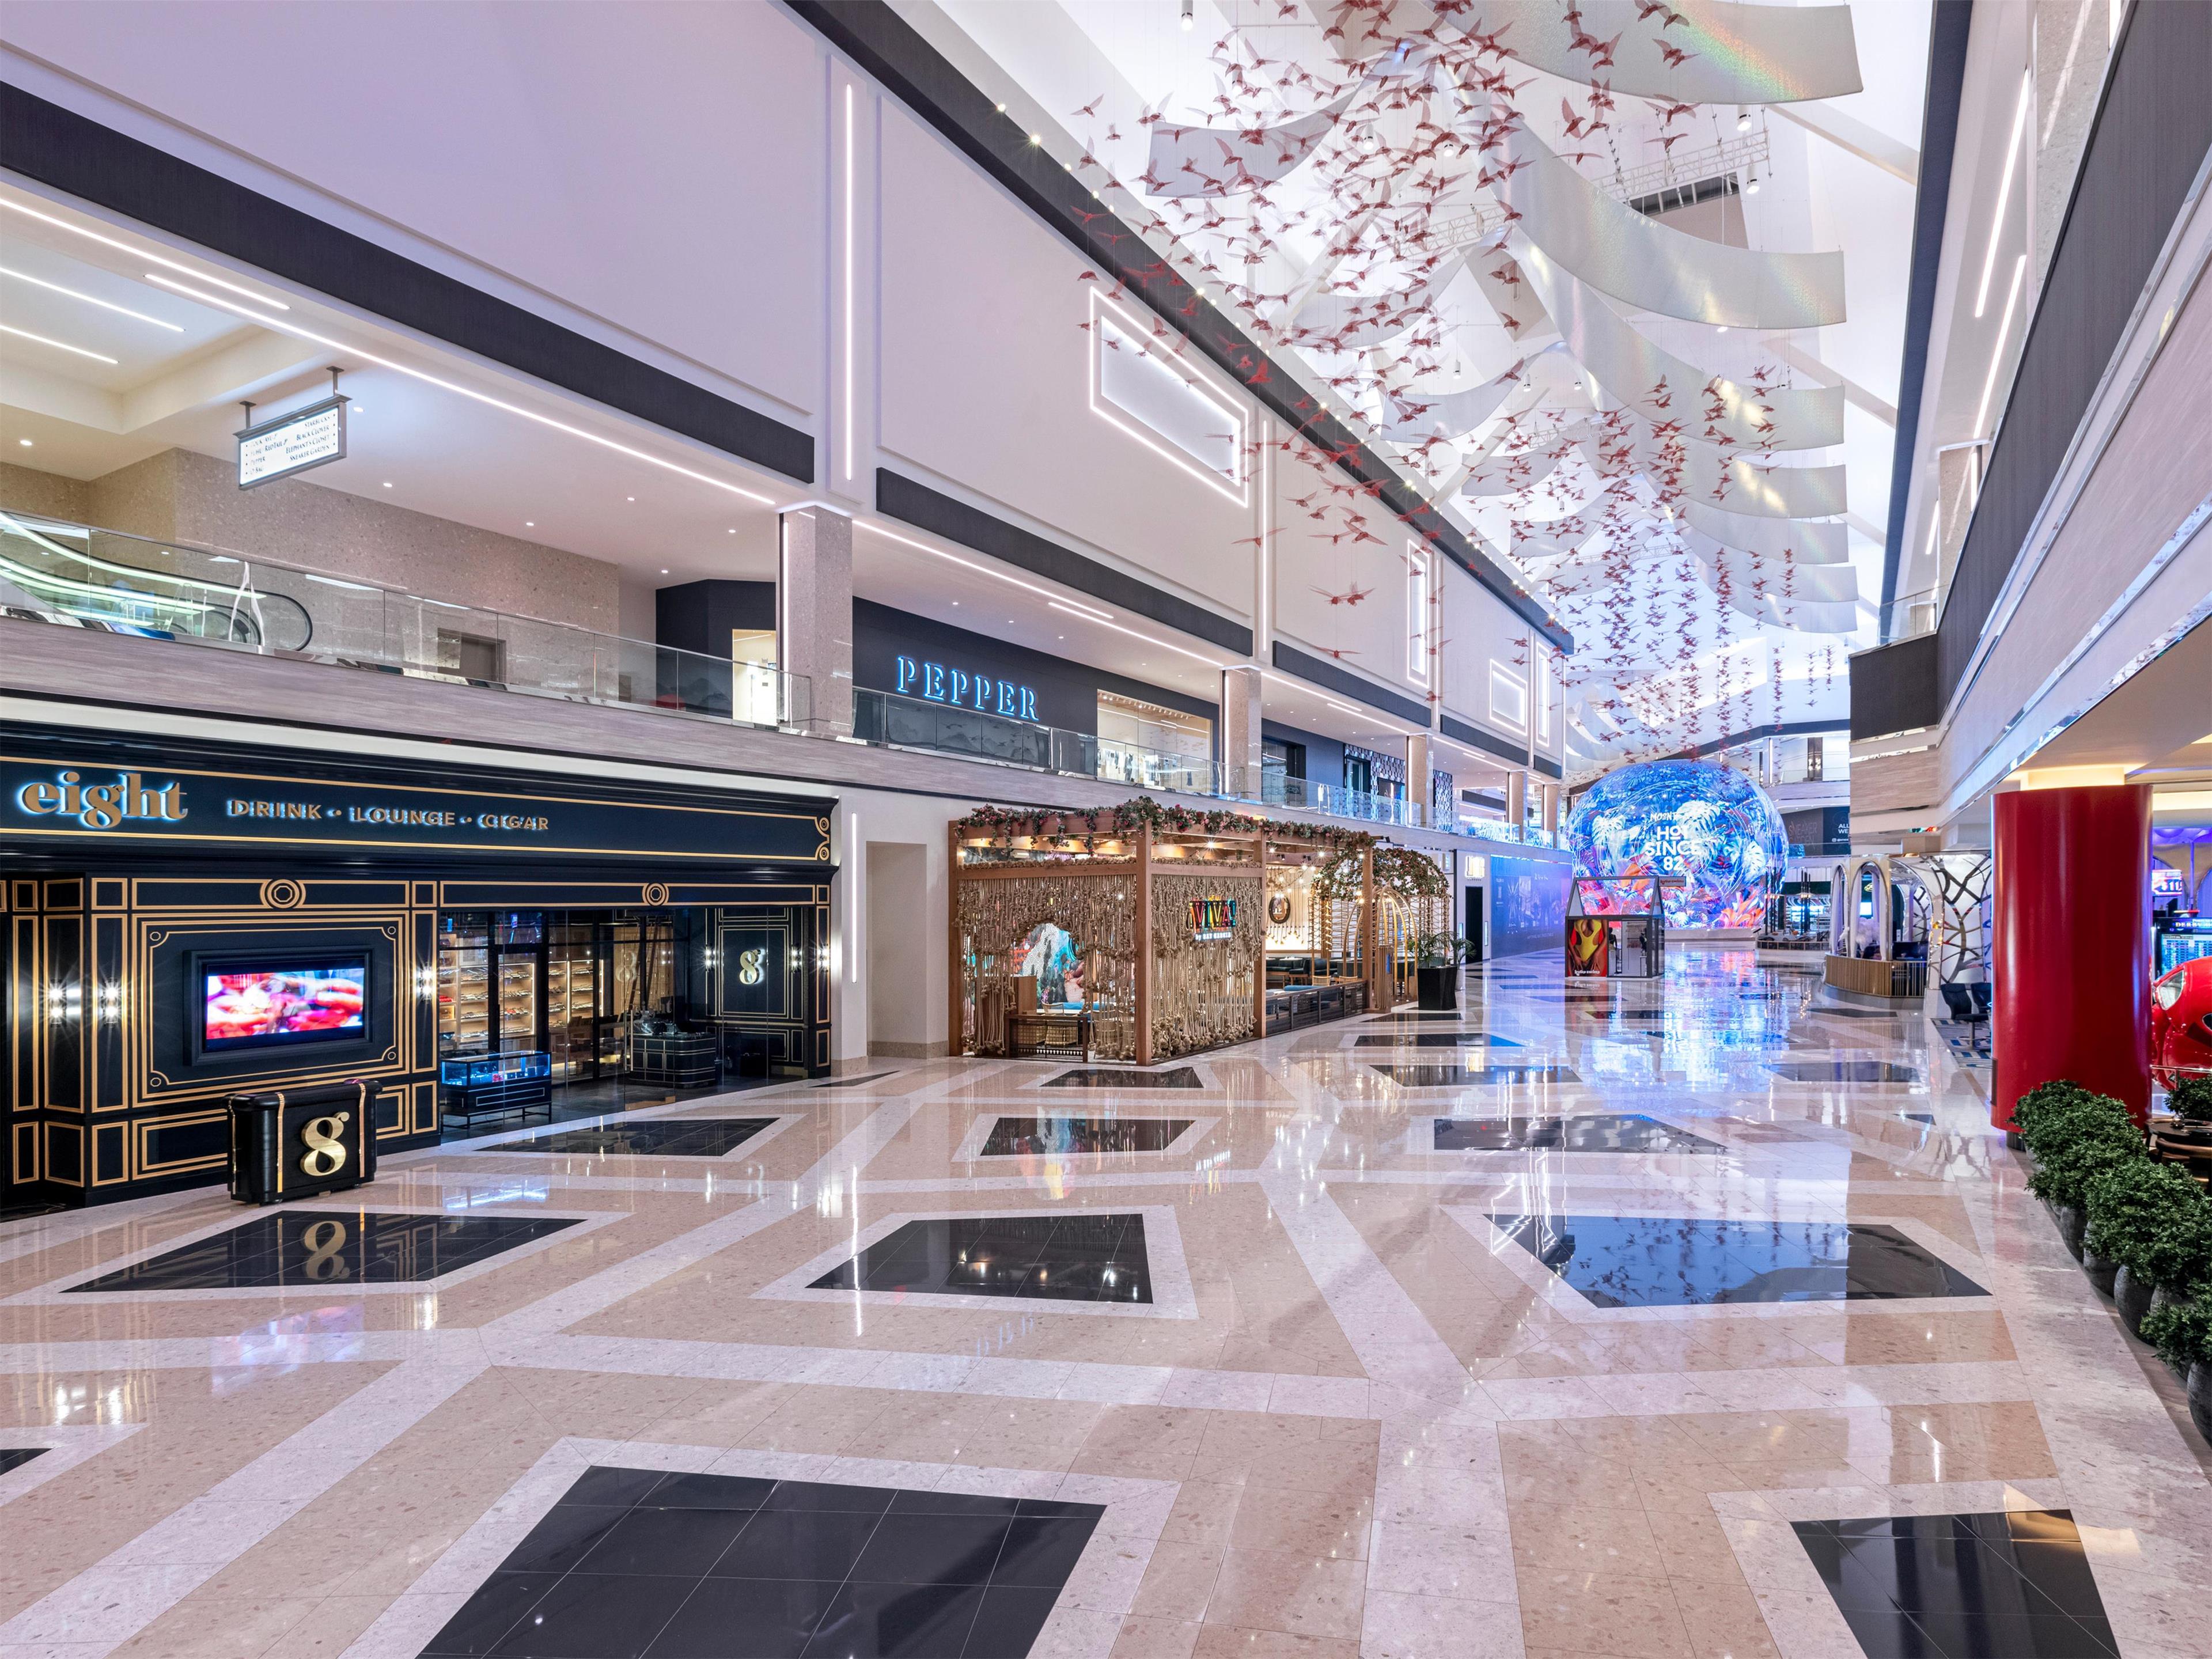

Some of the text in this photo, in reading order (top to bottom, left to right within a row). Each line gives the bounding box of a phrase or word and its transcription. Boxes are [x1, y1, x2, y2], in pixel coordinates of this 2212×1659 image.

[296, 425, 330, 441] BLACK CLOVER
[290, 445, 330, 462] SNEAKER GARDEN
[897, 656, 1039, 721] PEPPER
[21, 771, 188, 829] eight
[229, 799, 550, 831] DRINK LOUNGE CIGAR
[1657, 825, 1691, 840] HOT
[1645, 839, 1702, 857] SINCE
[1664, 856, 1685, 870] 82
